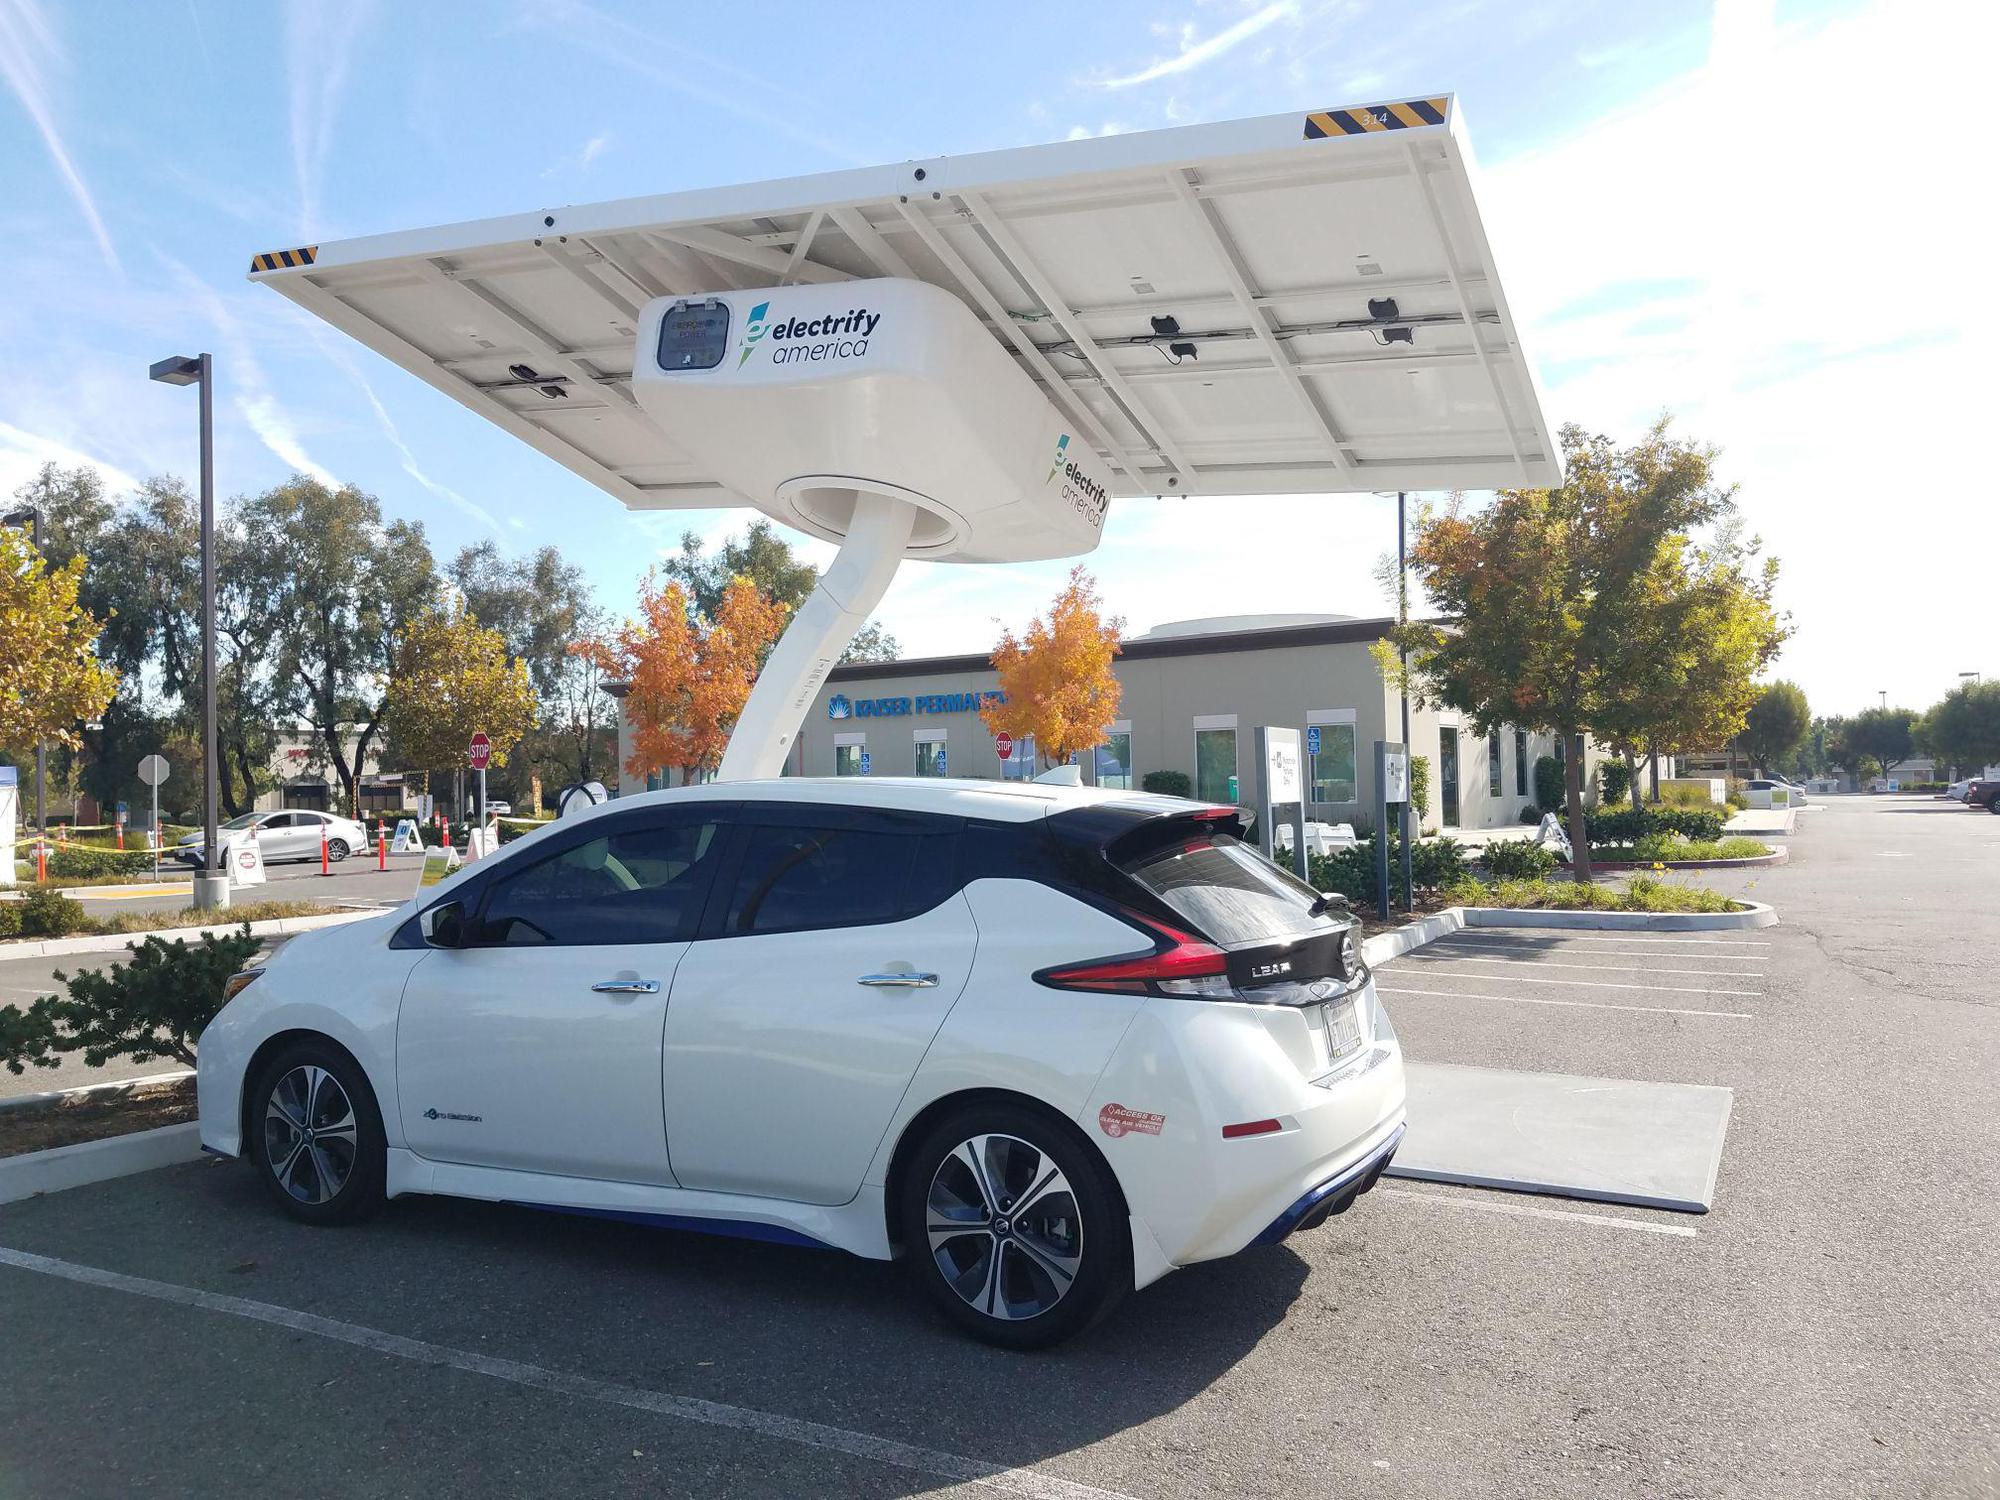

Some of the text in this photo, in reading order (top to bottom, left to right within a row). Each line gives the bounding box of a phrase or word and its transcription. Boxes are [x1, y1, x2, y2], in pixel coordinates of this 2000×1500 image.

[1362, 112, 1388, 127] 314
[772, 308, 881, 341] electrify
[772, 338, 869, 365] america
[1065, 462, 1108, 513] electrify
[1061, 484, 1100, 527] america
[854, 697, 912, 718] KAISER
[470, 744, 490, 759] STOP
[996, 740, 1012, 752] STOP
[1114, 1108, 1165, 1122] ACCESS OK
